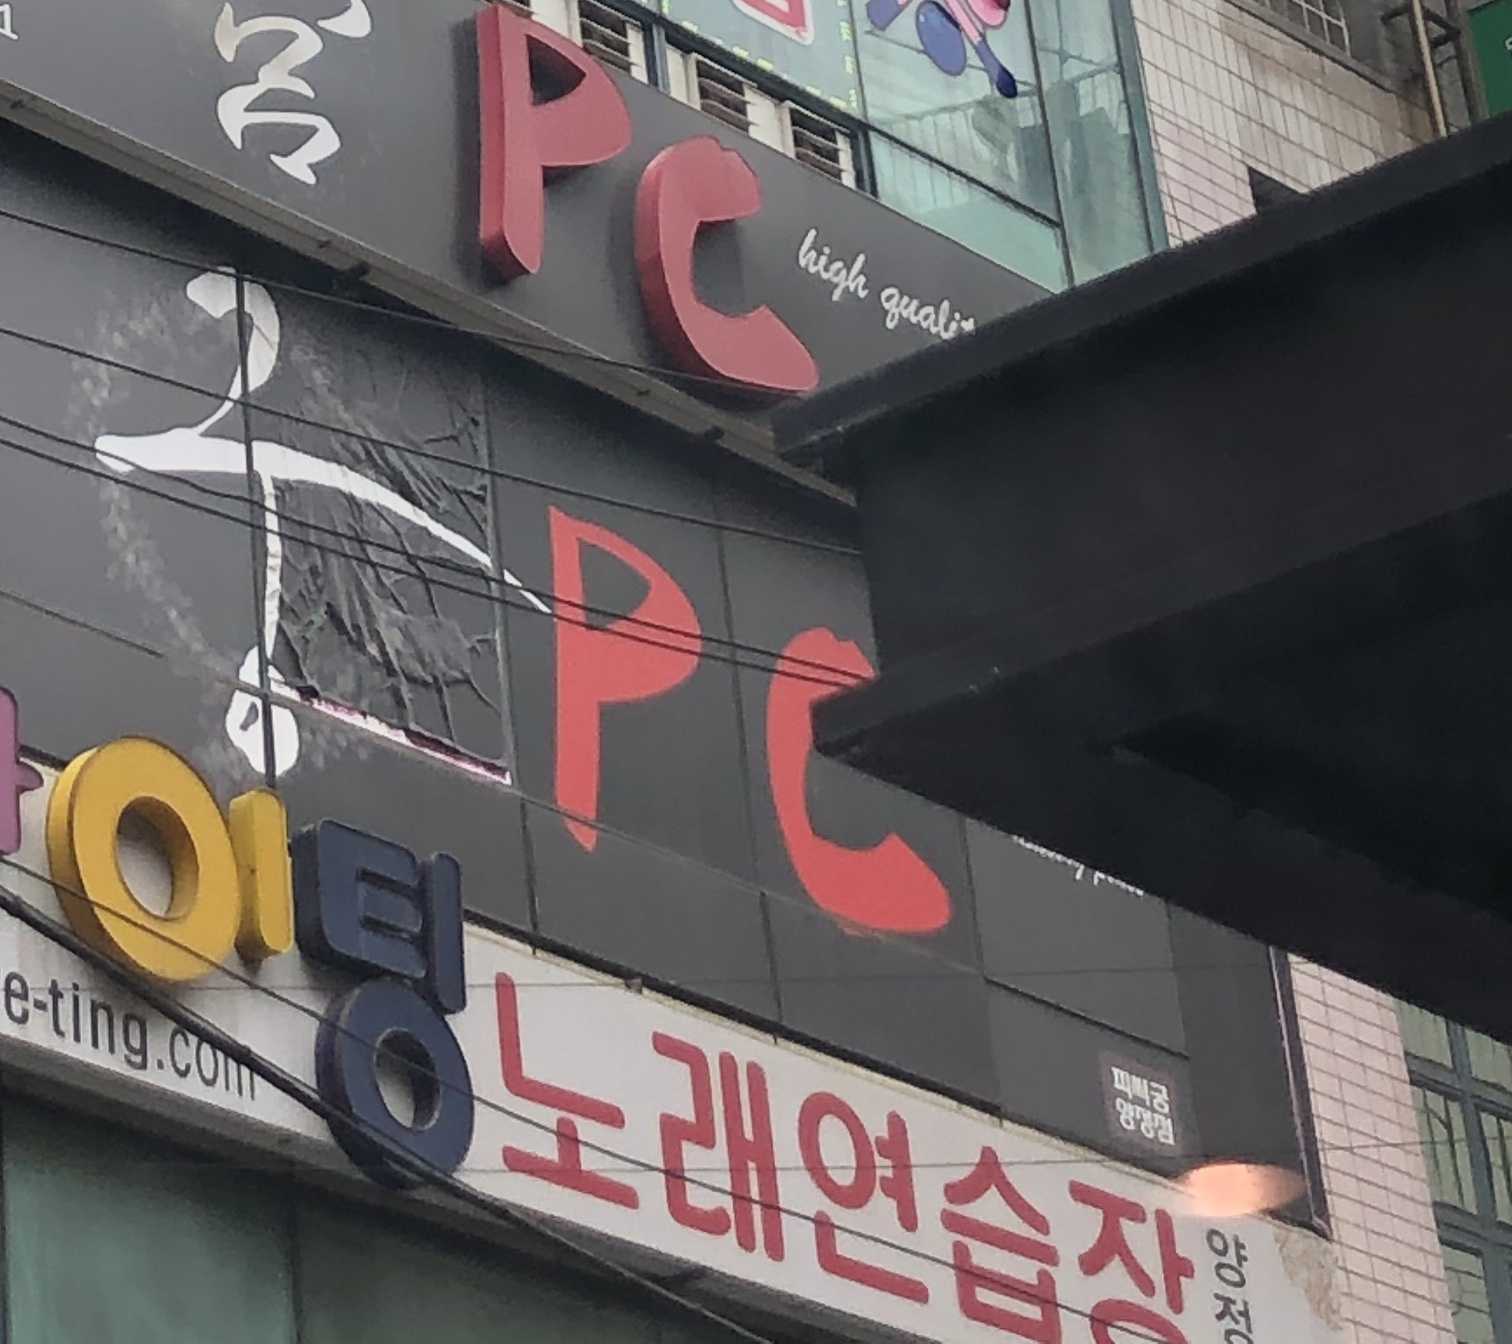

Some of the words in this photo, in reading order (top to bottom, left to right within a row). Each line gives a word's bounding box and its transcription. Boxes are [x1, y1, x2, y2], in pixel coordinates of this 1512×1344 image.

[476, 0, 820, 394] PC
[798, 227, 870, 303] high
[546, 505, 955, 936] PC
[1111, 1065, 1170, 1115] 피씨궁
